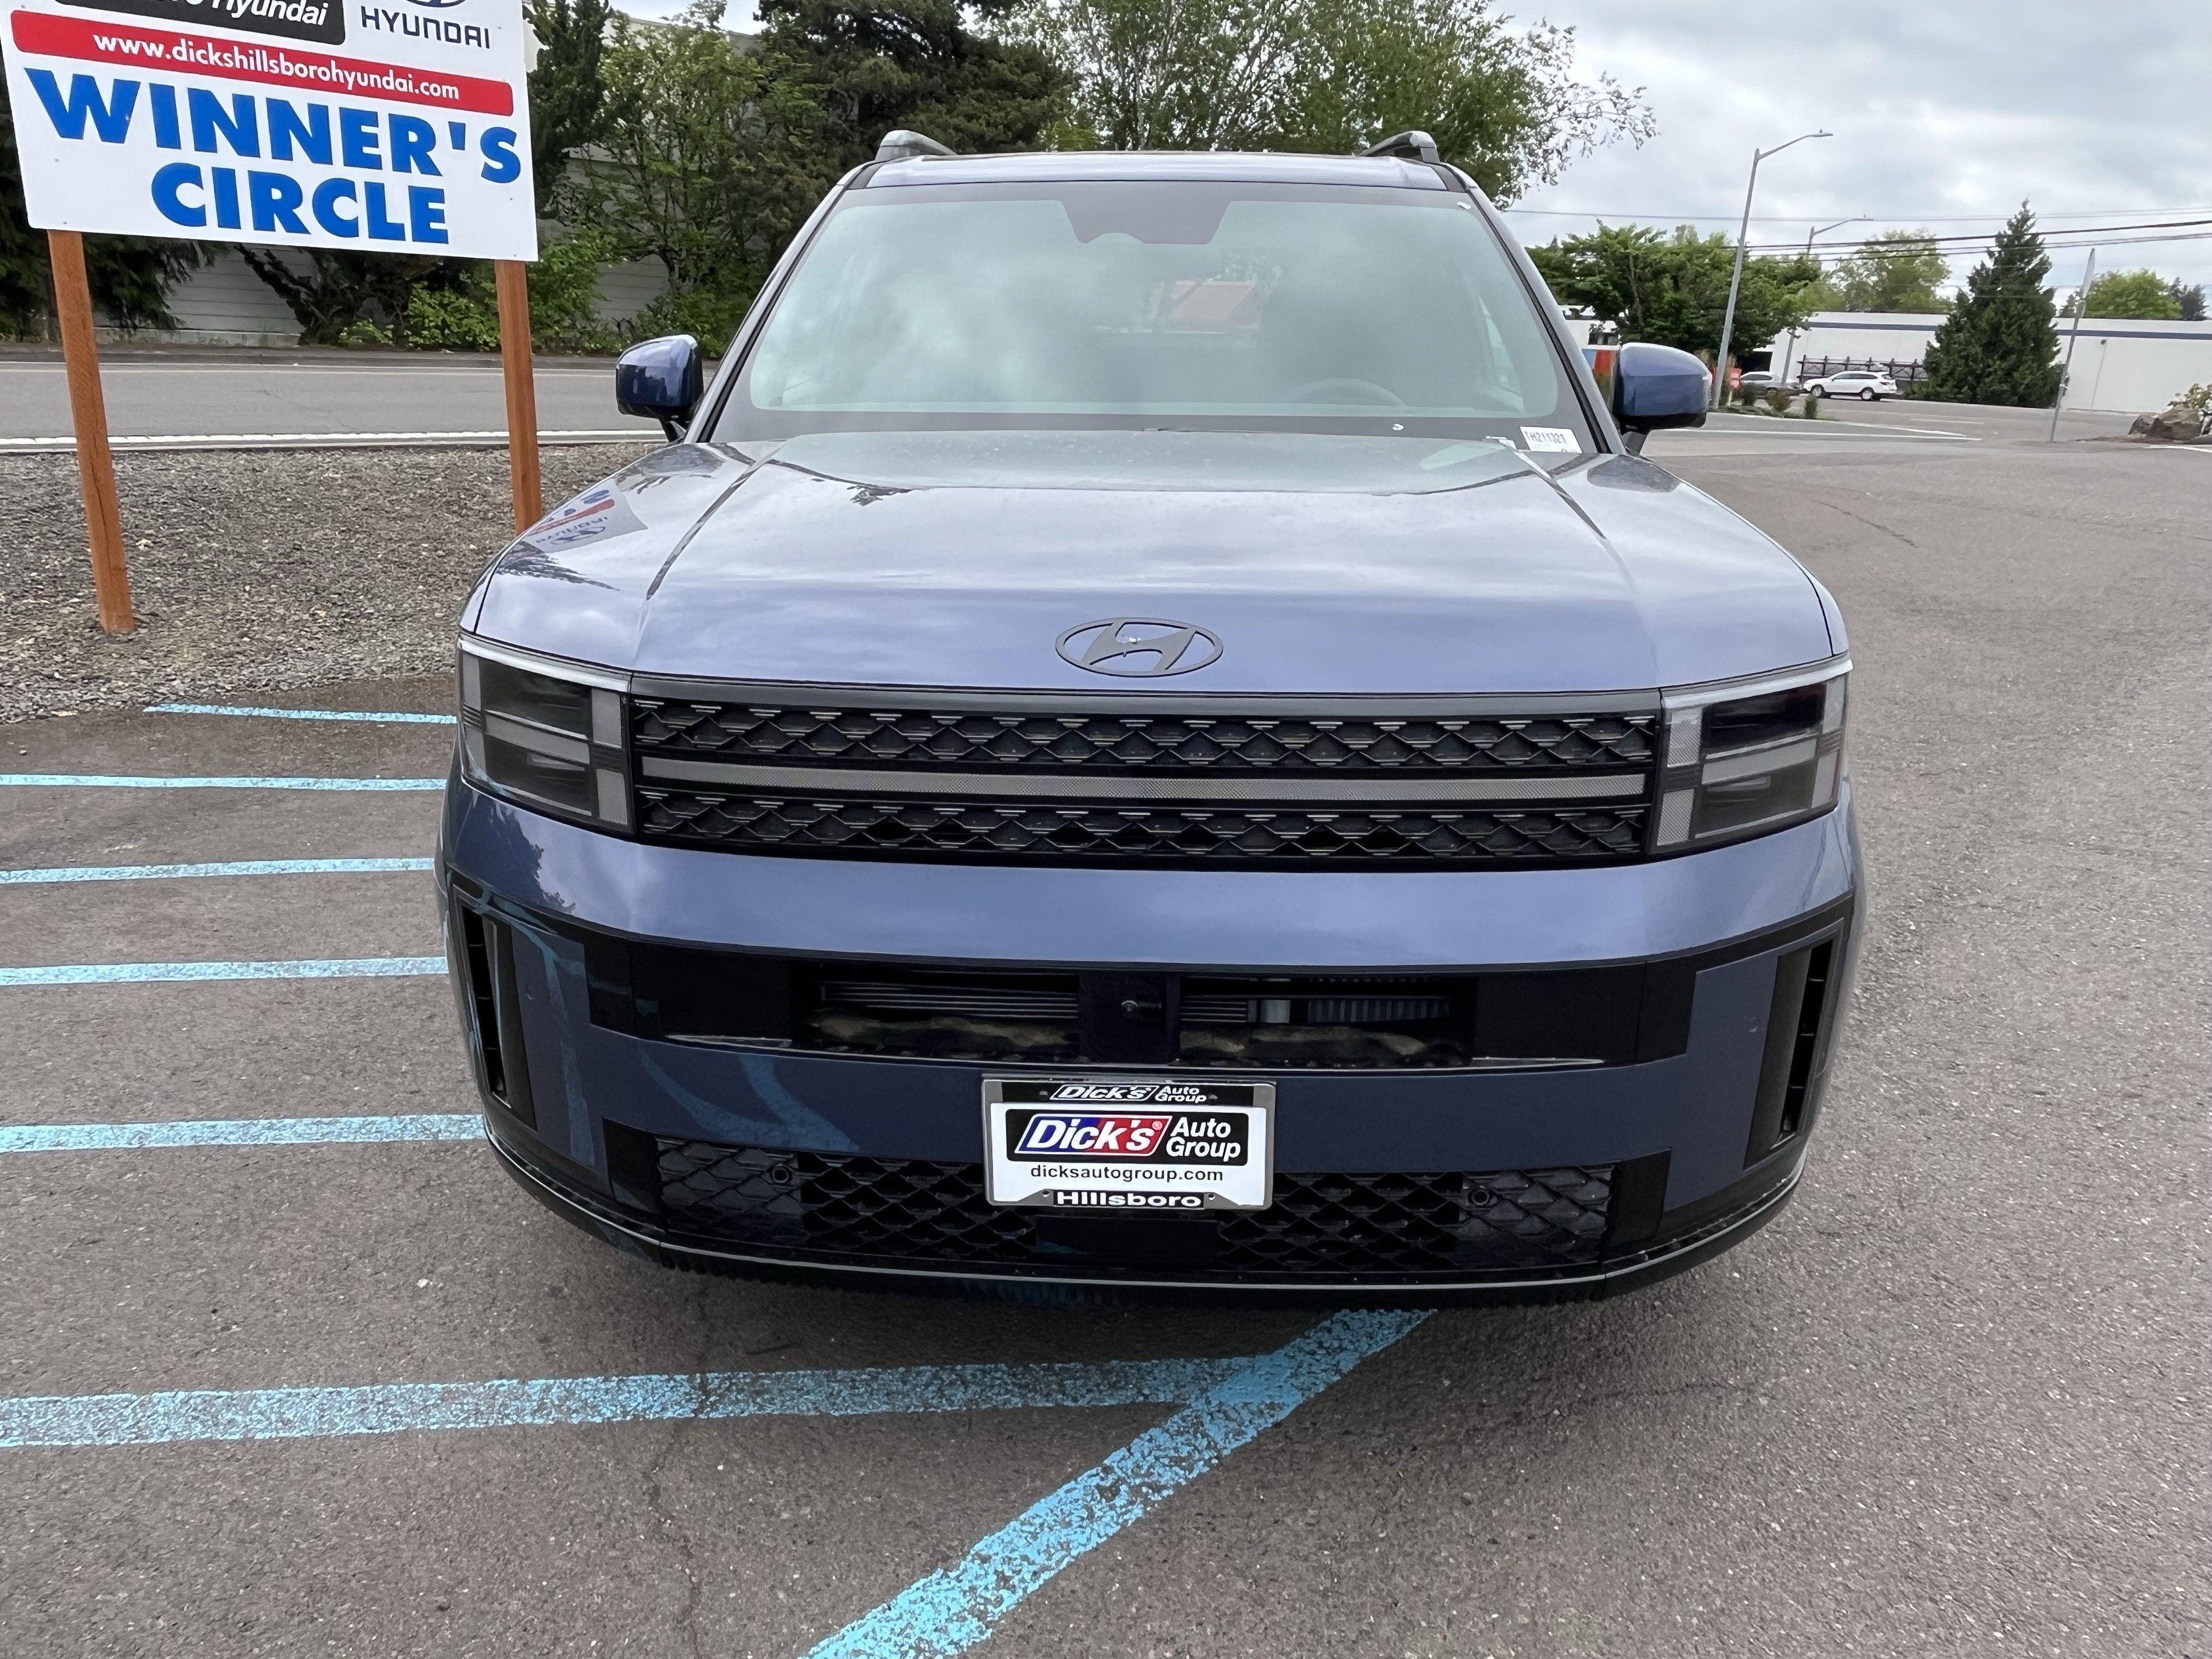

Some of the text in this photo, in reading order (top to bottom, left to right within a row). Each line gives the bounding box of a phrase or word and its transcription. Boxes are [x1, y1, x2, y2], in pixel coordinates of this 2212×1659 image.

[361, 6, 490, 49] HYUNDAI
[93, 35, 460, 100] www.dickshillsborohyundai.com
[24, 67, 522, 184] WINNER'S
[151, 162, 449, 245] CIRCLE
[1059, 1085, 1151, 1099] Dick's
[1155, 1094, 1207, 1104] Group
[1161, 1086, 1200, 1095] Auto
[1026, 1119, 1155, 1151] Dick's
[1170, 1116, 1231, 1138] Auto
[1166, 1136, 1241, 1162] Group
[1030, 1165, 1223, 1182] dicksautogroup.com
[1057, 1191, 1202, 1207] Hillsboro
